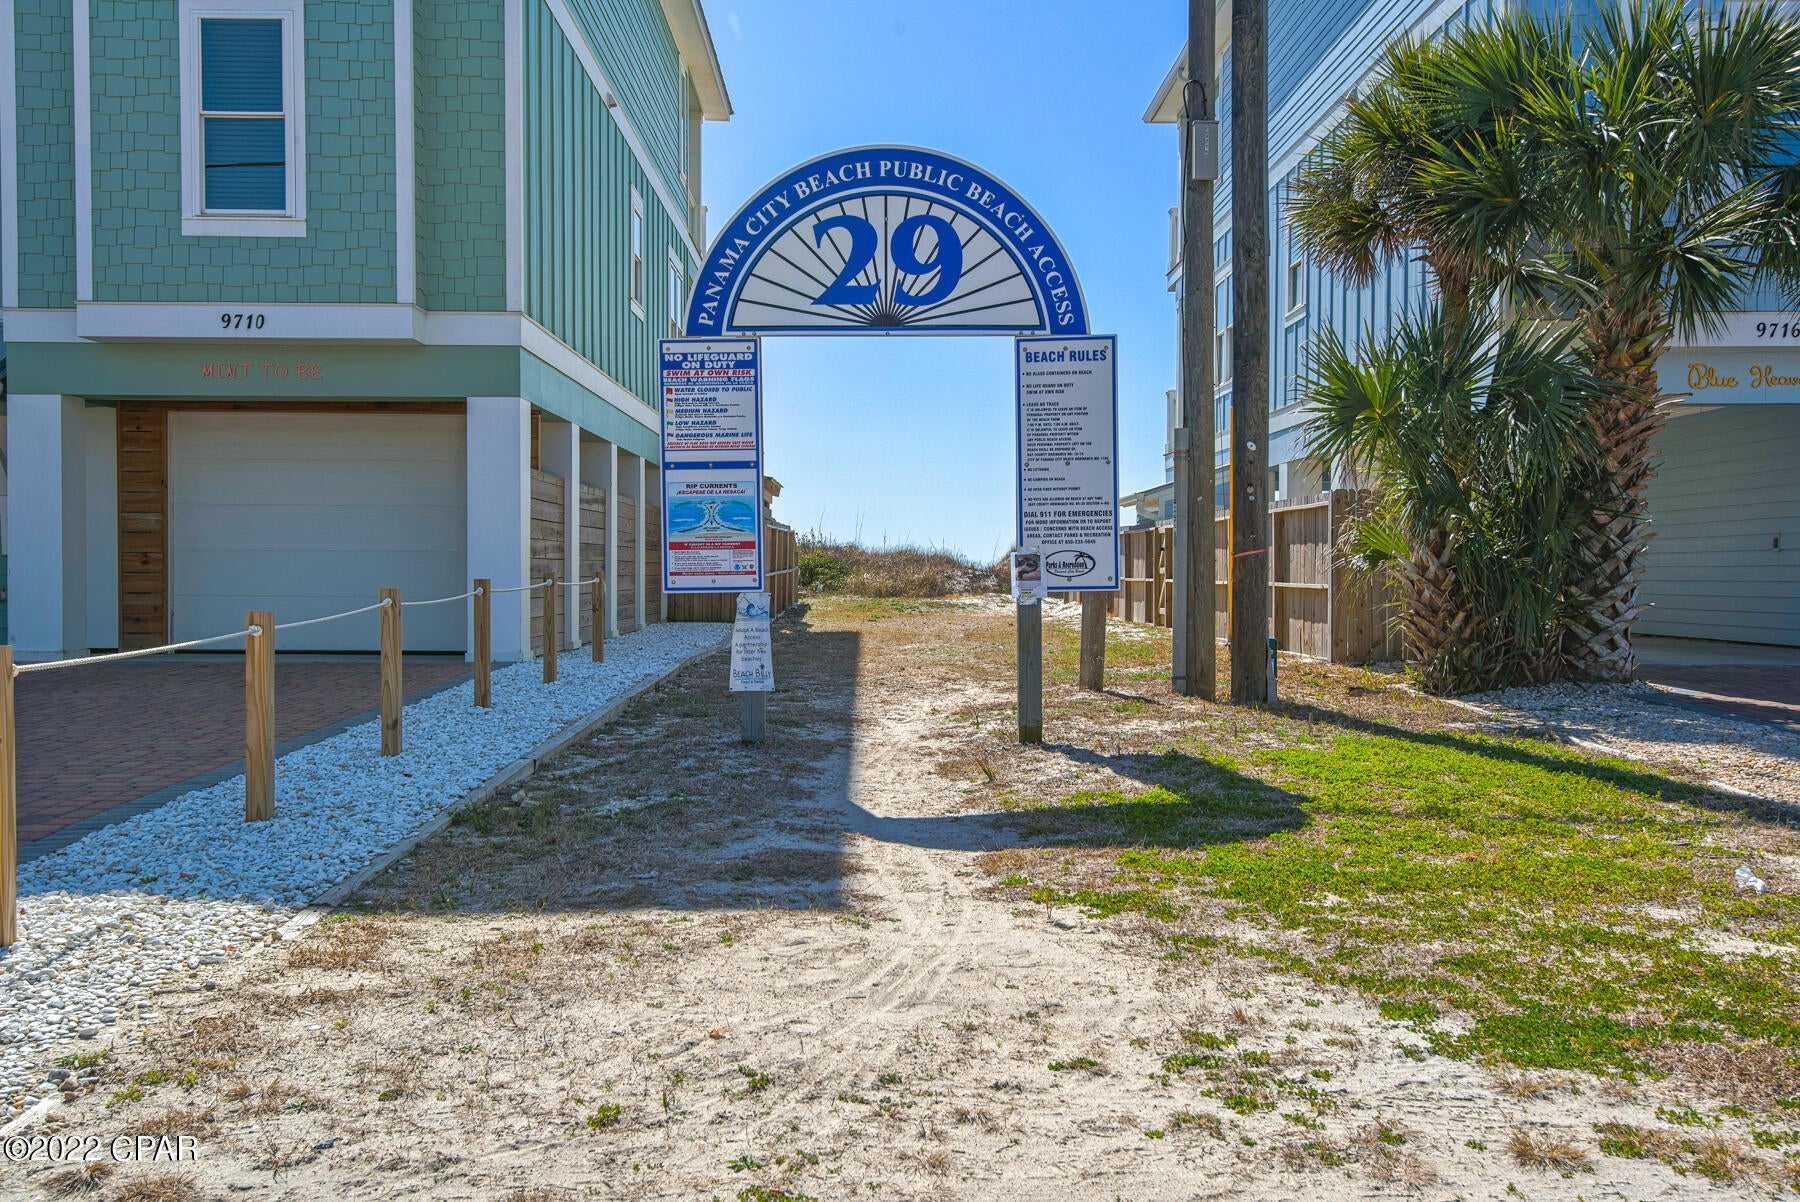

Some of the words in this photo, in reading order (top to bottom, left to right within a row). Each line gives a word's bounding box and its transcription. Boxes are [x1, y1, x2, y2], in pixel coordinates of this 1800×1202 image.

[698, 238, 748, 327] PANAMA
[746, 191, 792, 236] CITY
[794, 161, 871, 200] BEACH
[880, 160, 964, 192] PUBLIC
[966, 182, 1034, 243] BEACH
[1029, 245, 1074, 325] ACCESS
[811, 215, 963, 306] 29
[221, 313, 265, 329] 9710
[1757, 322, 1800, 338] 9716
[688, 353, 752, 361] LIFEGUARD
[1025, 351, 1064, 363] BEACH
[1070, 350, 1106, 361] RULES
[202, 363, 253, 378] MINT
[261, 363, 288, 379] TO
[296, 363, 324, 380] BE
[1688, 363, 1738, 390] Blue
